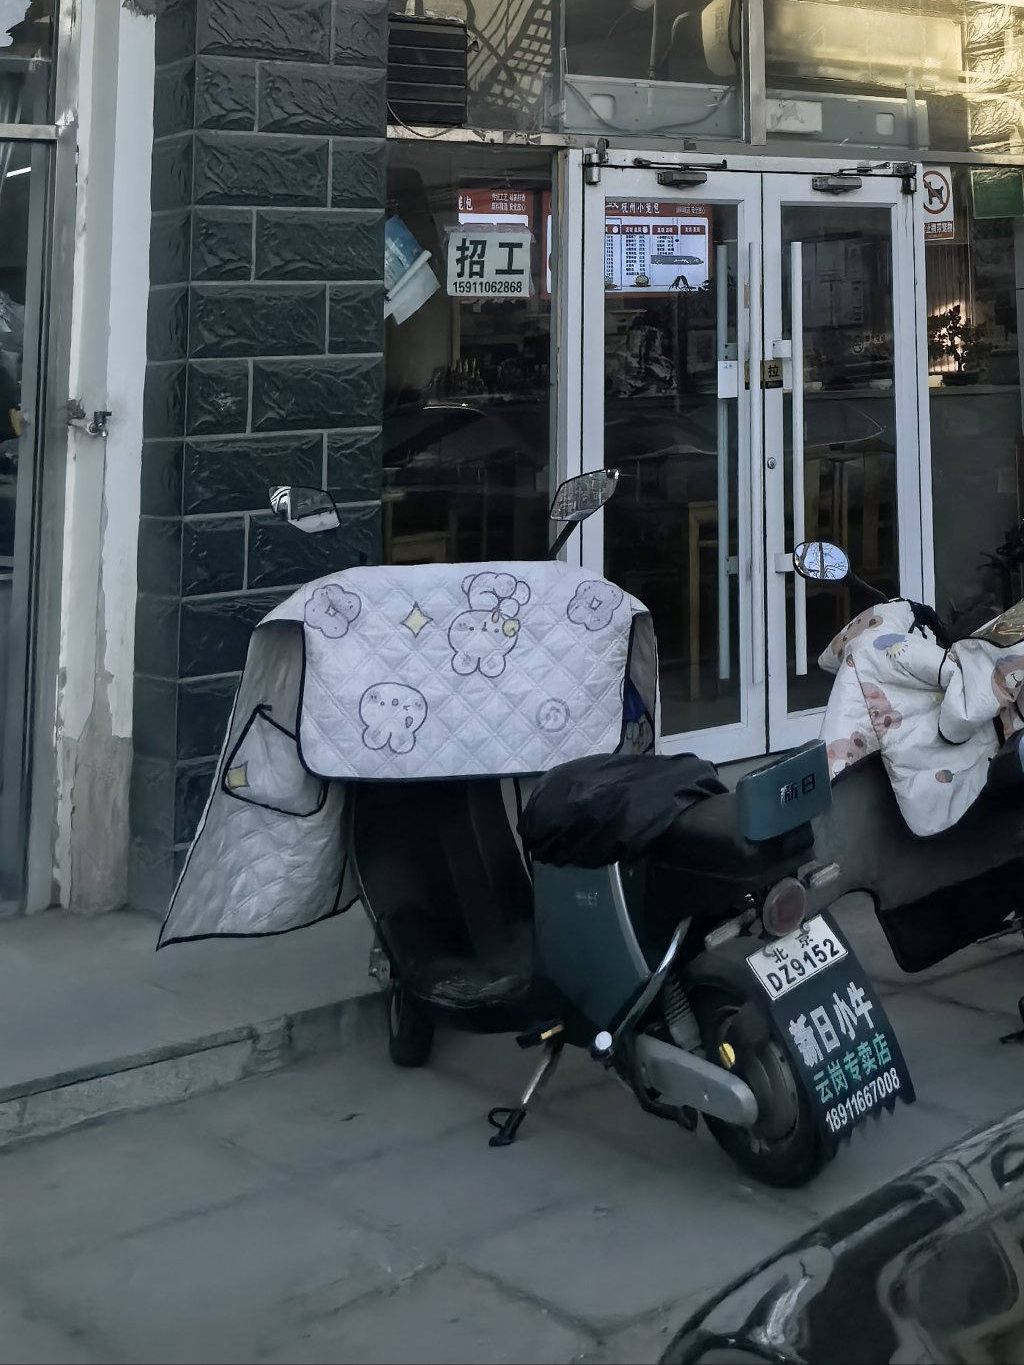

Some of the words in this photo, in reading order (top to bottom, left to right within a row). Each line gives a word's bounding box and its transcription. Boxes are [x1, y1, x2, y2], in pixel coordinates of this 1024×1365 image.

[456, 238, 525, 279] 招工
[452, 280, 523, 294] 15911062868
[766, 938, 840, 992] DZ9152
[813, 1032, 893, 1104] 云岗专卖店
